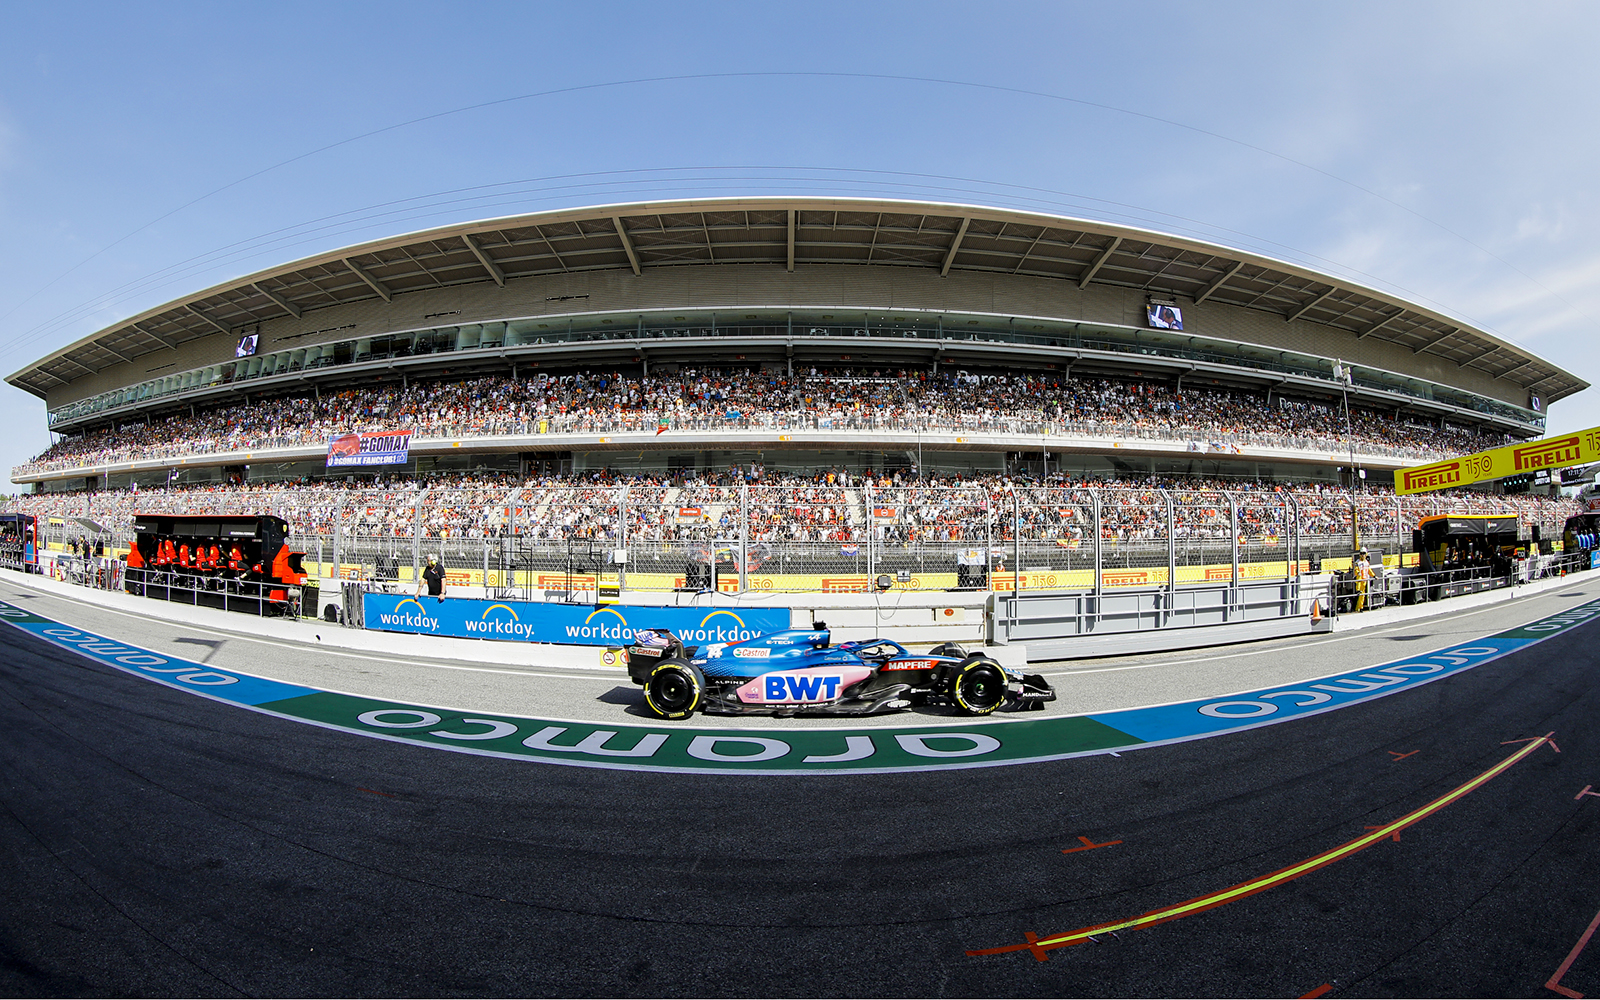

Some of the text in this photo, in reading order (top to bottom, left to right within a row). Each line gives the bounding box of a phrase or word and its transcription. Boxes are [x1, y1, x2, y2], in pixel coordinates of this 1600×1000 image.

[360, 435, 411, 452] #GOMAX
[1513, 436, 1581, 470] PIRELLI
[1403, 455, 1493, 490] PIRELLI 150
[1032, 574, 1057, 589] 150
[1102, 571, 1148, 586] PIRELLI
[381, 612, 440, 631] workday.
[465, 618, 535, 638] workday.
[43, 628, 241, 686] aramco
[637, 648, 660, 656] Castrol
[888, 661, 932, 670] MAPFRE
[765, 676, 841, 701] BWT
[1198, 645, 1500, 719] aramco
[356, 709, 1002, 764] aramco
